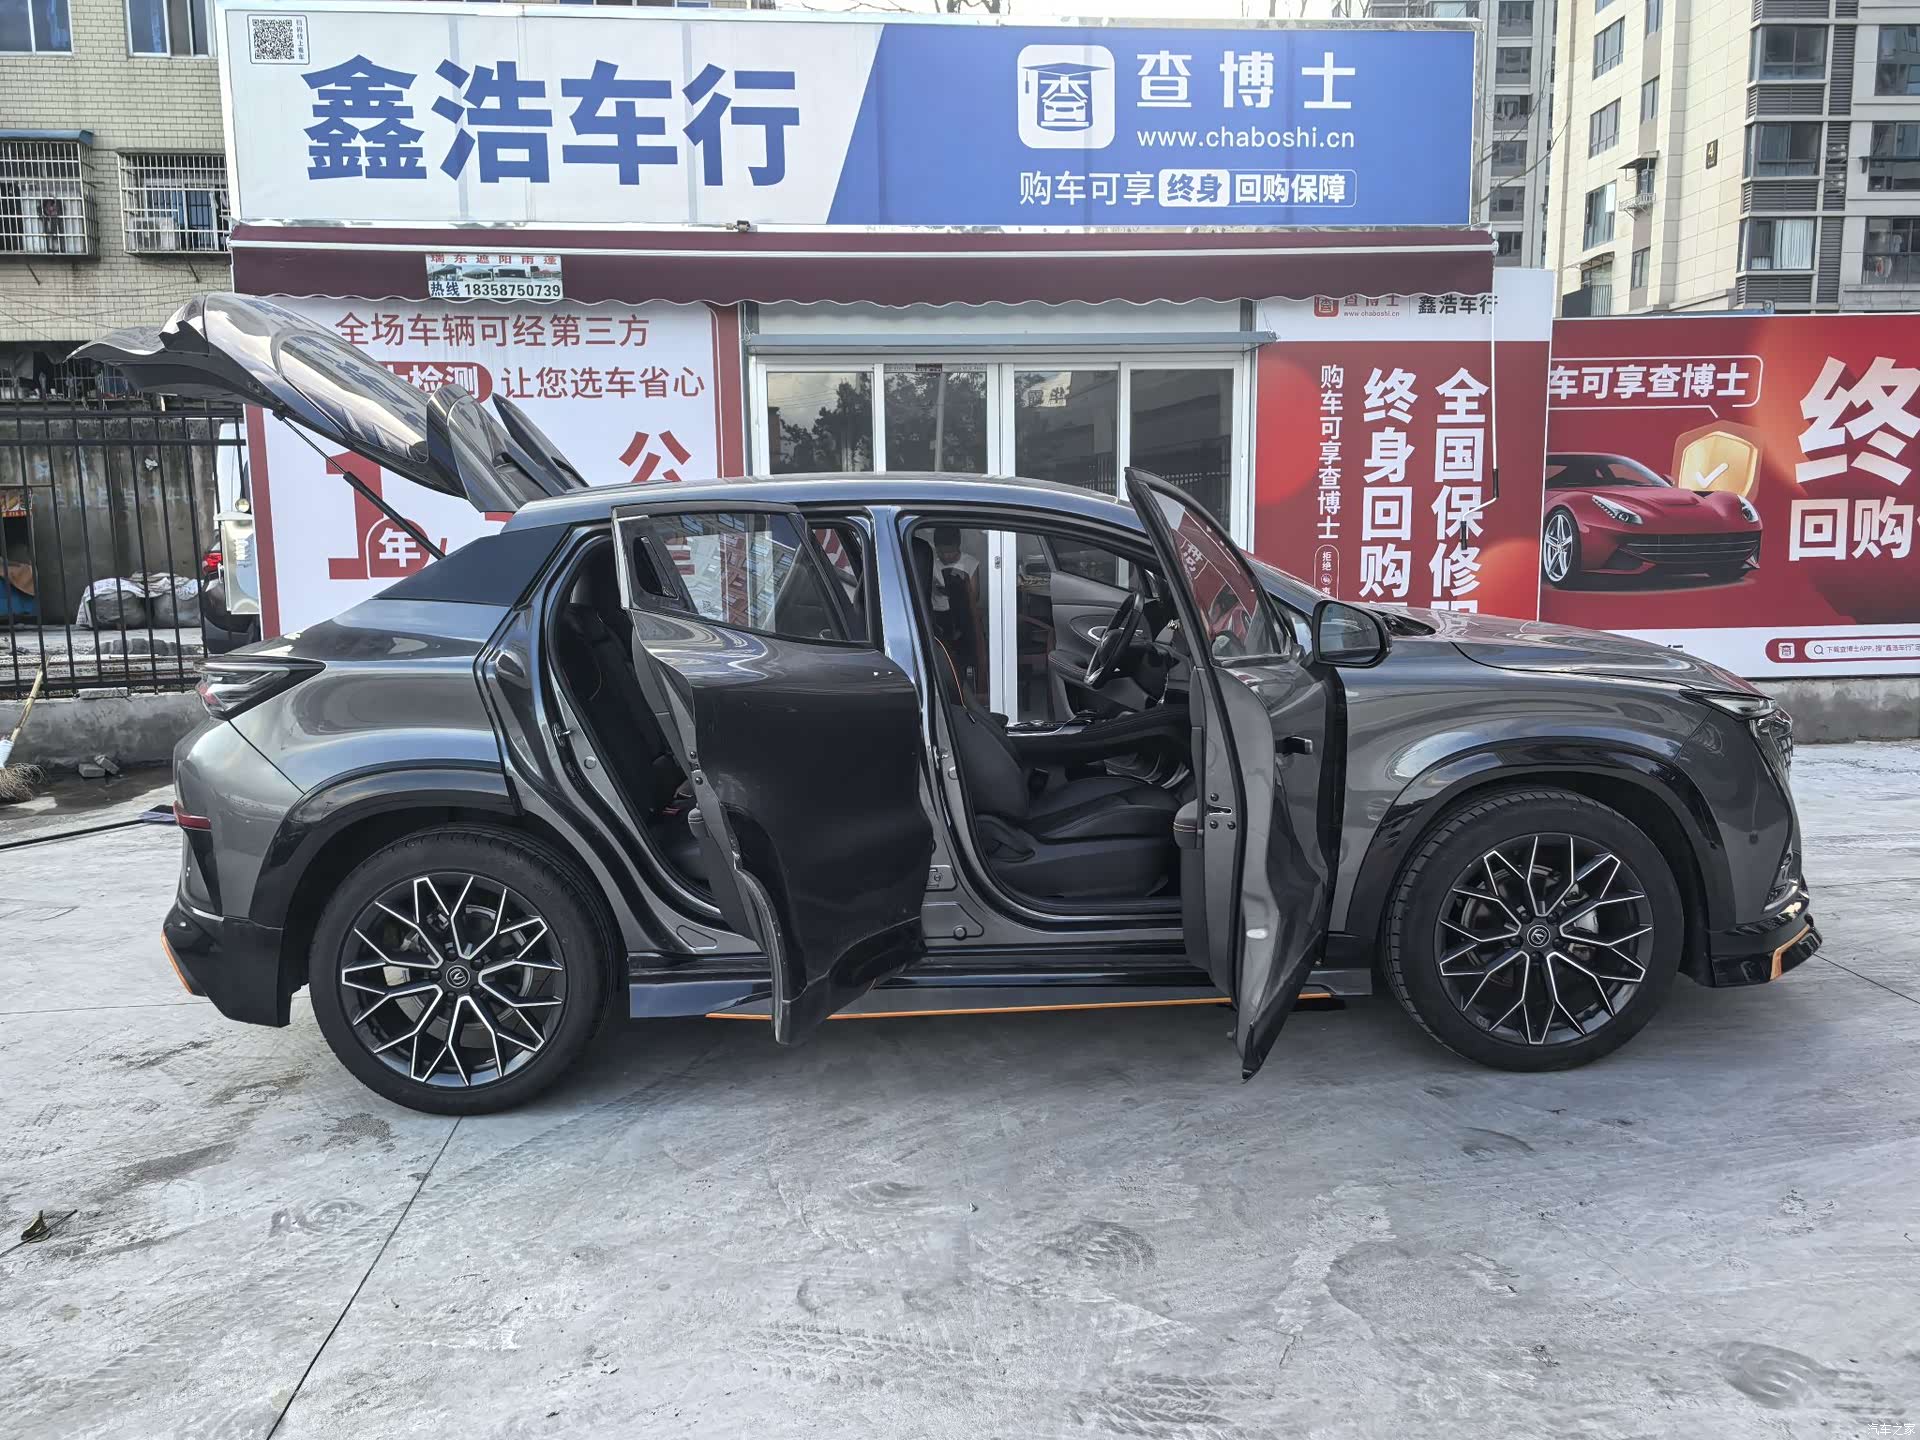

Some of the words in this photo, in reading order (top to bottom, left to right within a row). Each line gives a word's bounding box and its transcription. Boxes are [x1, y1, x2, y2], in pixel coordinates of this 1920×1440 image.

[1136, 50, 1356, 110] 查博士
[300, 54, 800, 187] 鑫浩车行
[1136, 126, 1356, 149] www.chaboshi.cn
[1019, 171, 1155, 206] 购车可享
[1166, 172, 1223, 203] 终身
[1234, 173, 1346, 204] 回购保障
[430, 281, 460, 297] 热线
[464, 283, 561, 297] 18358750739
[1418, 295, 1498, 315] 鑫浩车行
[334, 311, 650, 347] 全场车辆可经第三方
[501, 366, 705, 400] 让您选车省心
[1795, 355, 1920, 487] 终
[1317, 364, 1344, 539] 购车可享查博士
[378, 527, 421, 568] 年
